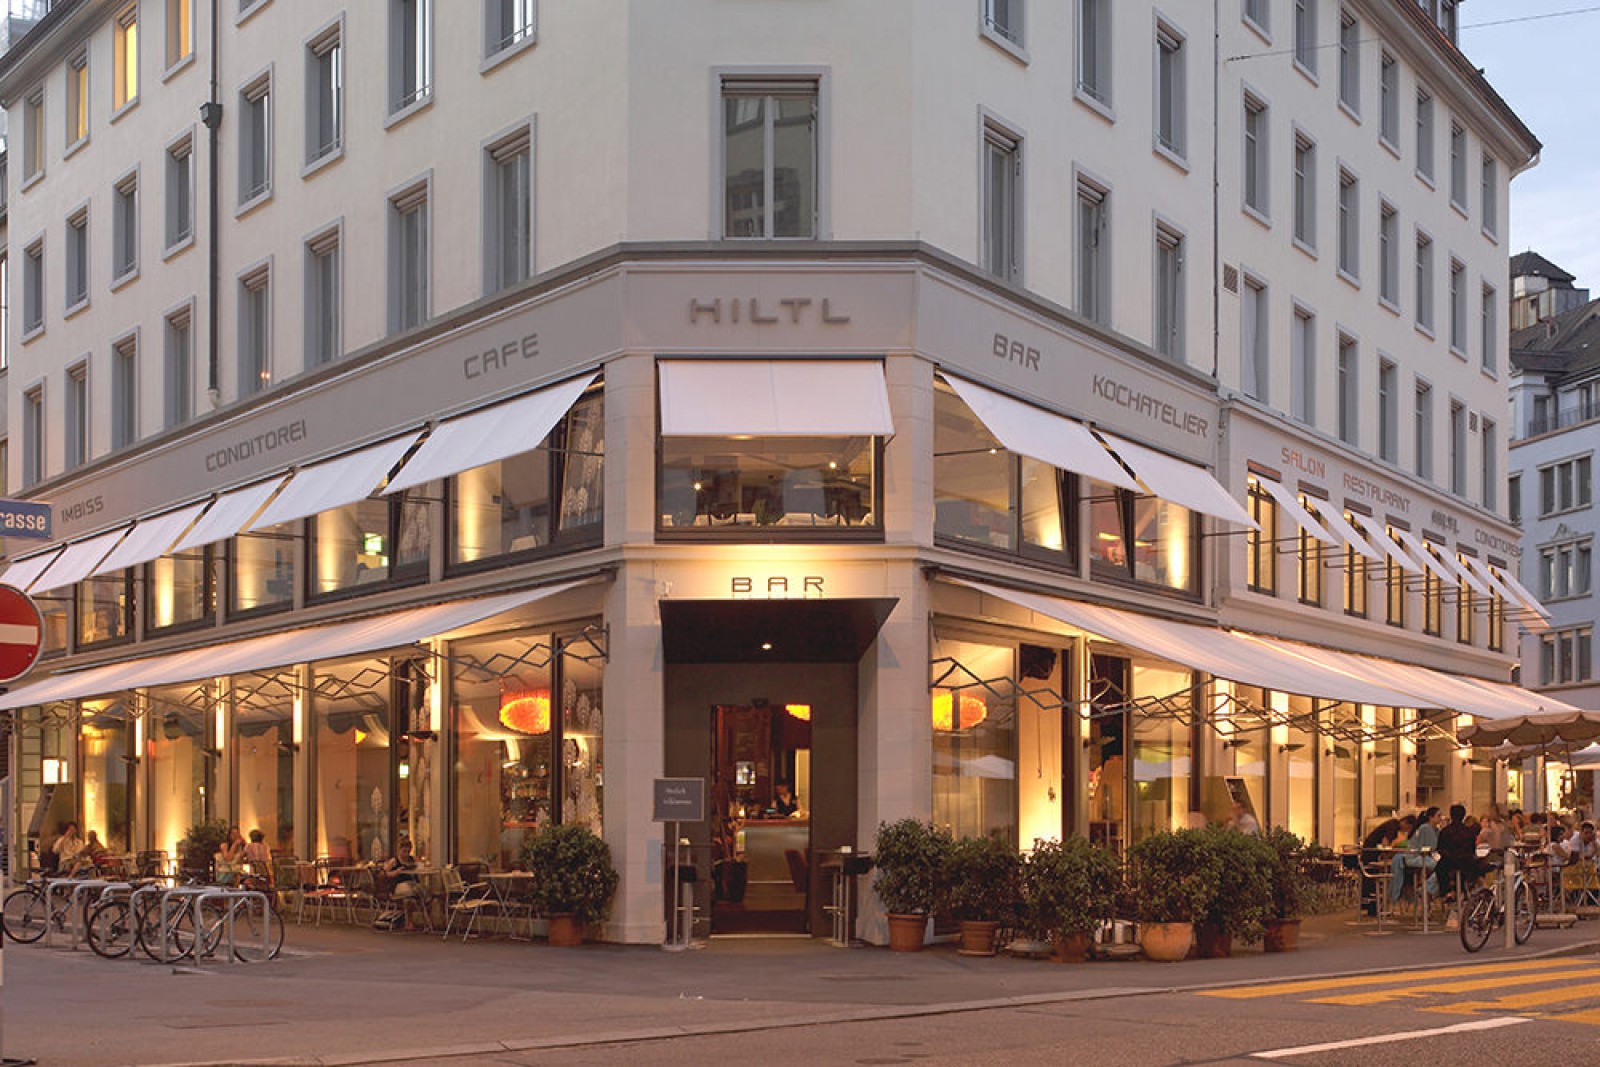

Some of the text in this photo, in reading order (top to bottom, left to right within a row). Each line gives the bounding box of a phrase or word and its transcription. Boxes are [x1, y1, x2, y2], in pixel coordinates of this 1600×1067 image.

[689, 297, 851, 324] HILTL
[463, 333, 540, 380] CAFE
[993, 332, 1209, 438] BAR KOCHATELIER
[205, 418, 306, 473] CONDITOREI
[1281, 447, 1326, 478] SALON
[1343, 472, 1411, 513] RESTAURANT
[61, 496, 104, 523] IMBISS
[731, 576, 824, 592] BAR
